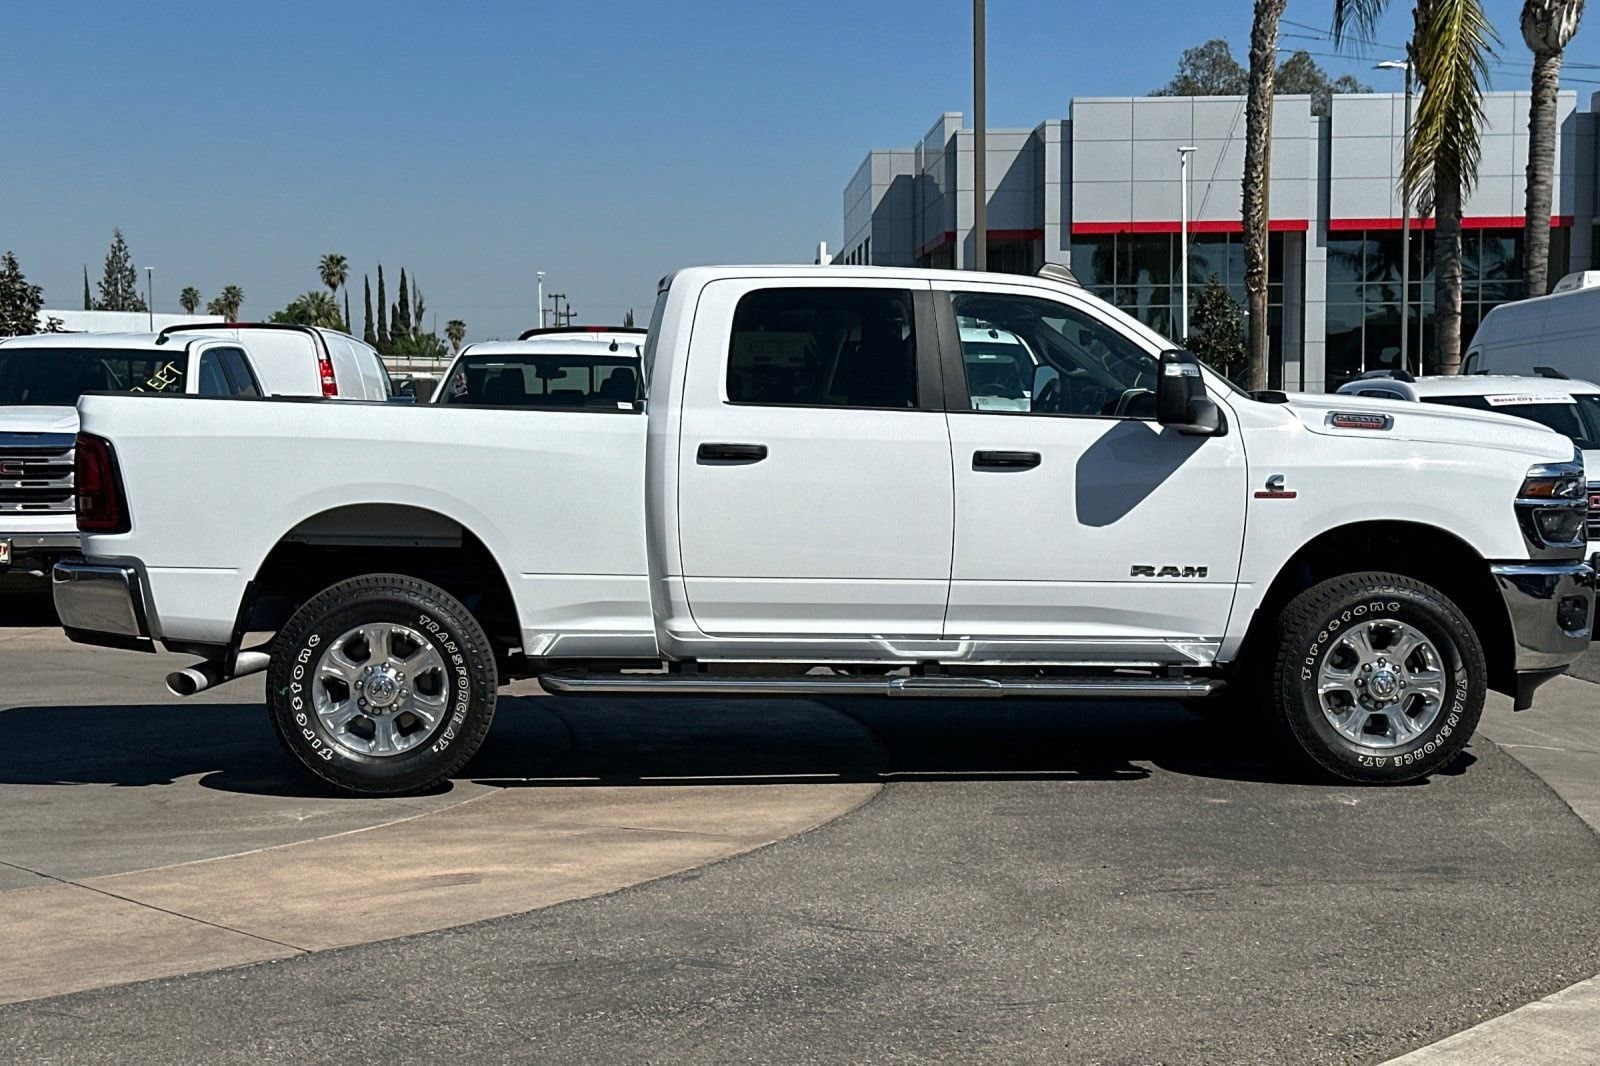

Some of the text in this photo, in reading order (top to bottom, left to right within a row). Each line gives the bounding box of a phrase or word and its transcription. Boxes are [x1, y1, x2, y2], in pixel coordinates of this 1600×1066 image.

[1130, 565, 1208, 578] RAM
[418, 614, 471, 725] TRANSFORCE
[1301, 602, 1401, 681] Firestone
[290, 634, 333, 761] Firestone
[1393, 679, 1468, 767] TRANSFORCE
